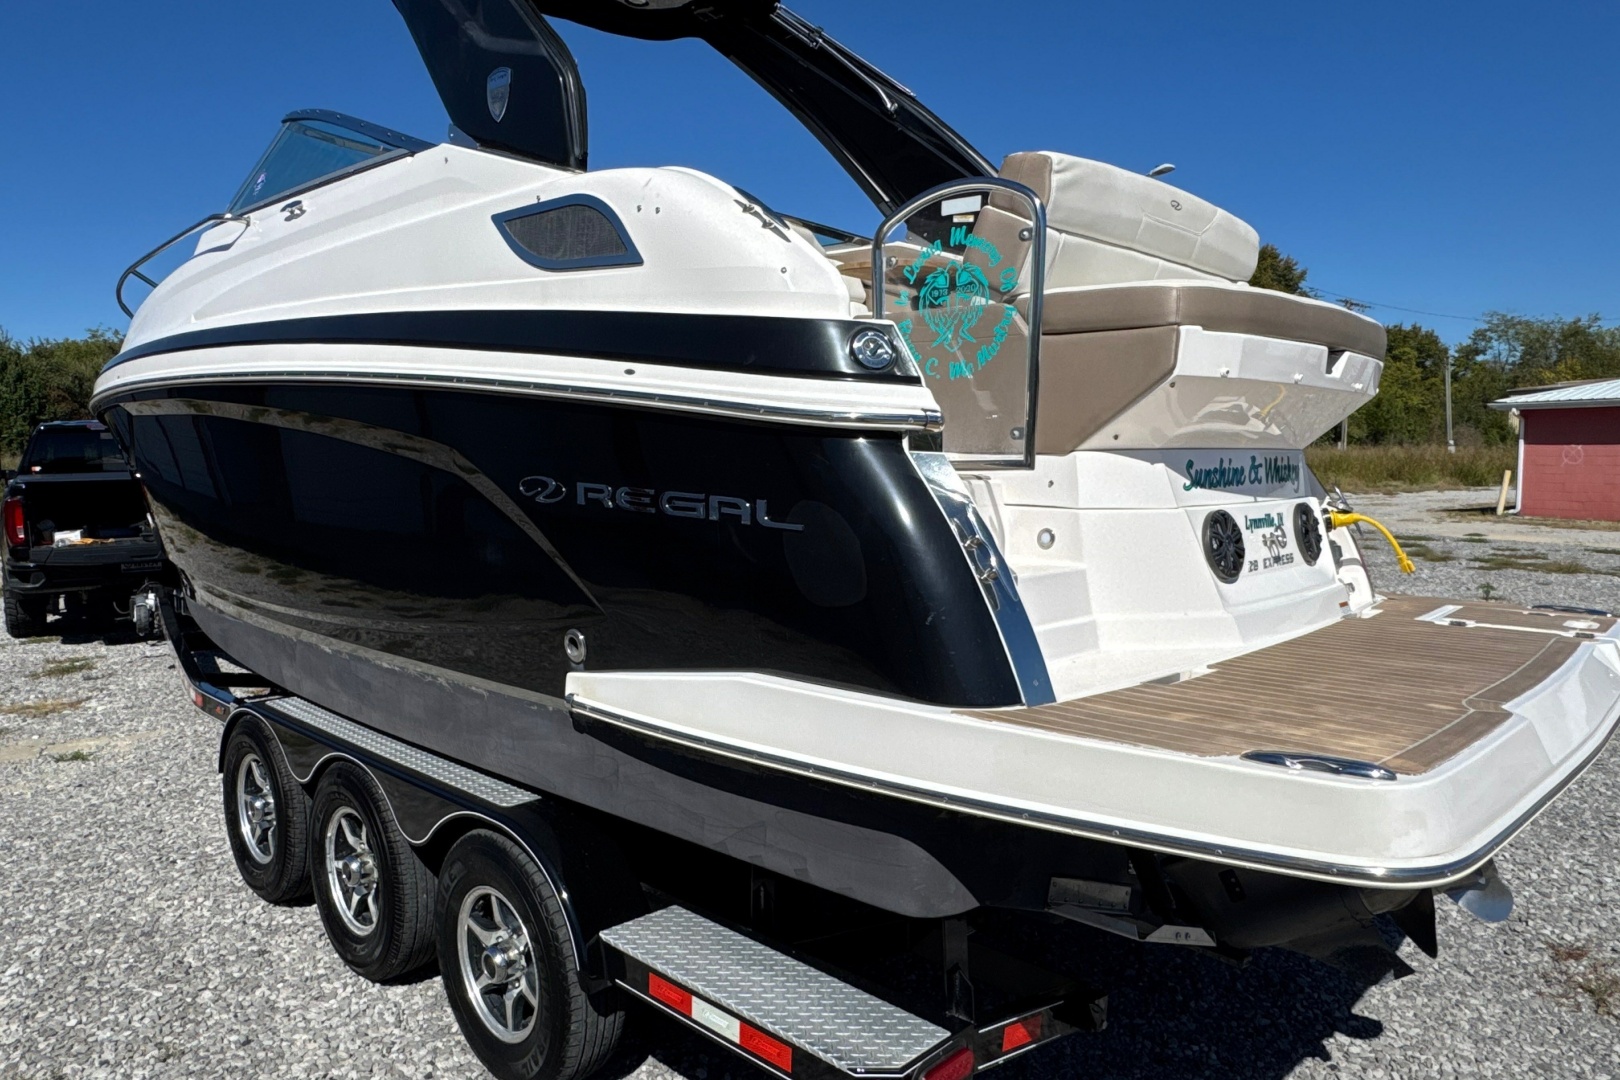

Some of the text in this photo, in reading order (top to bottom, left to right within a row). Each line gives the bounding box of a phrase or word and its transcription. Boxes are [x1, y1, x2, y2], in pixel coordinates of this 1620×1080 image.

[894, 290, 909, 306] In
[903, 239, 943, 285] Loving
[949, 225, 1003, 268] Memory
[931, 283, 976, 298] 1973 2020
[925, 357, 941, 379] C.
[949, 359, 974, 381] Mc
[1183, 457, 1247, 491] Sunshine
[1248, 455, 1263, 485] &
[576, 481, 804, 532] REGAL
[1247, 552, 1294, 573] 28 EXPRESS
